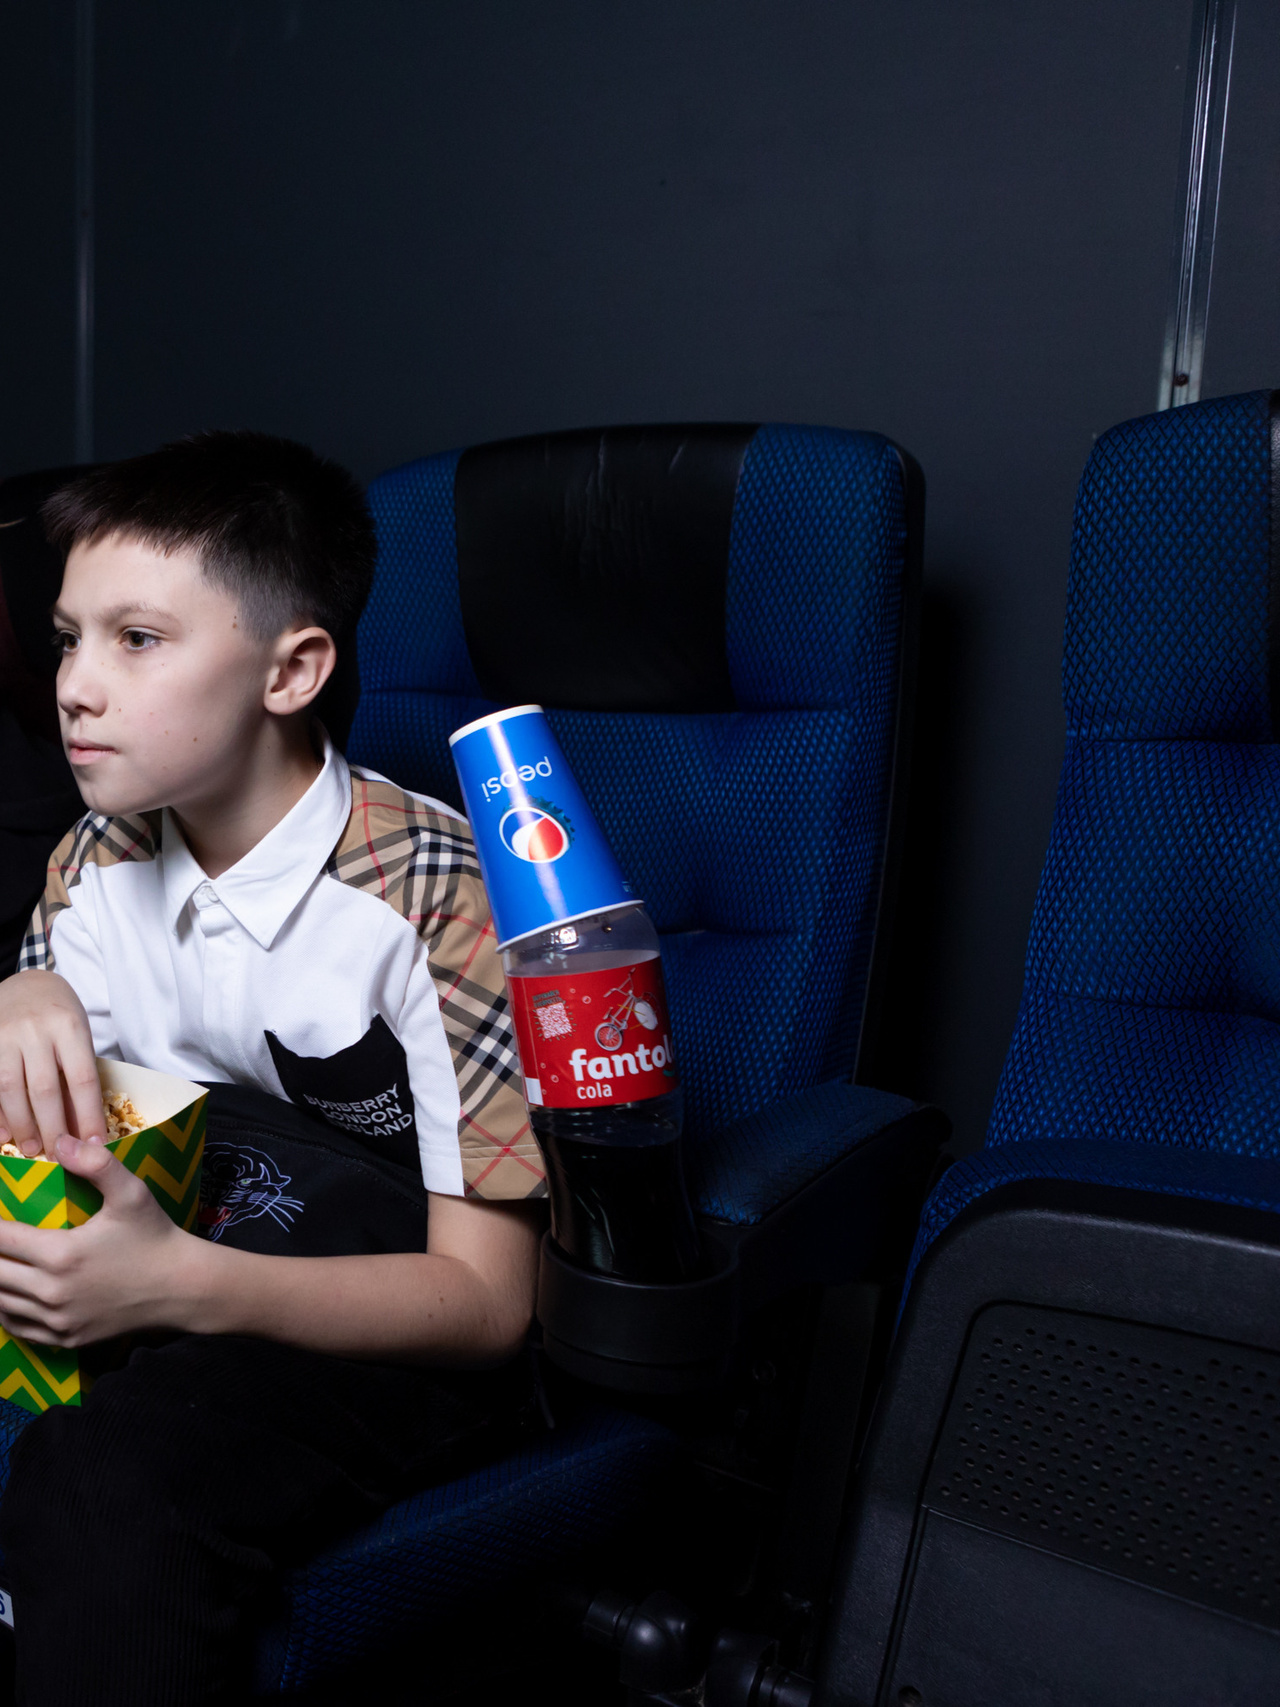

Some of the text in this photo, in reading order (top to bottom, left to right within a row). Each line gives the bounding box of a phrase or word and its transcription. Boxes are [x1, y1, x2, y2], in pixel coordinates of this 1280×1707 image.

[481, 756, 552, 802] pepsi
[568, 1034, 674, 1082] fantol
[303, 1083, 399, 1113] BURBERRY
[576, 1082, 613, 1100] cola
[320, 1102, 403, 1125] LONDON
